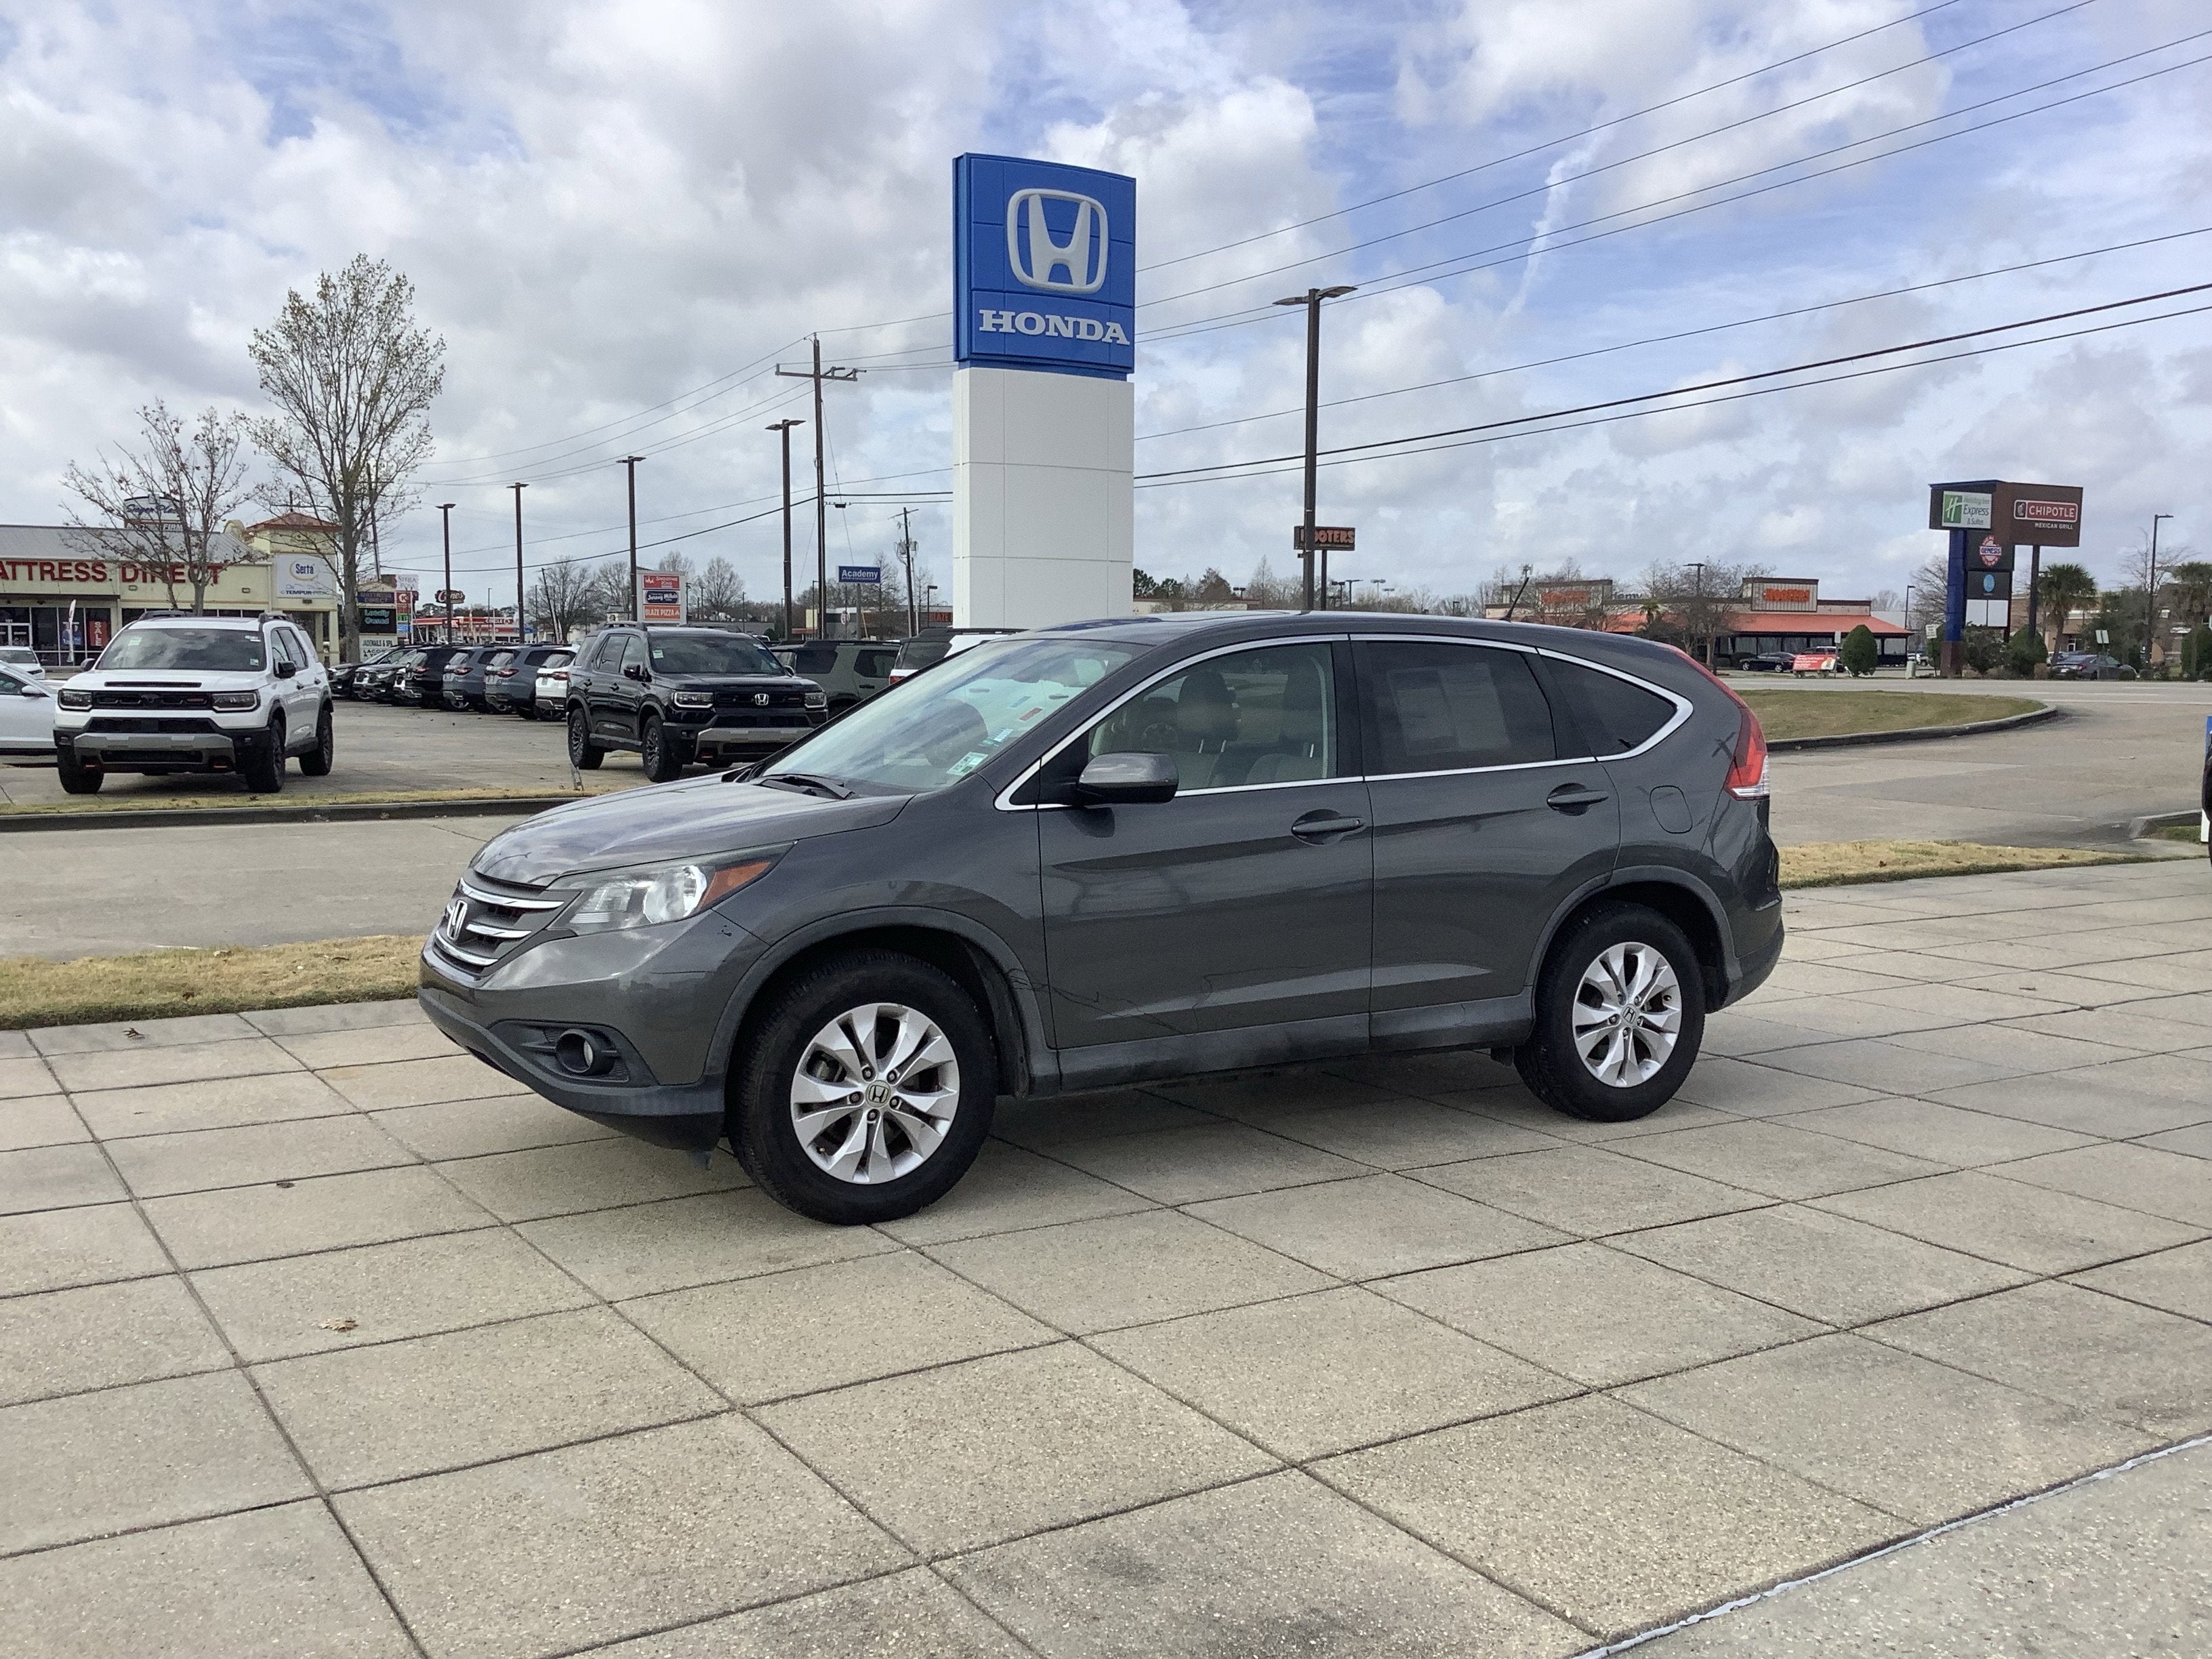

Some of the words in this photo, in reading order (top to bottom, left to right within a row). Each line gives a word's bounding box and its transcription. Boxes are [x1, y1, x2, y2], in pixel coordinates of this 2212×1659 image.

[979, 309, 1130, 346] HONDA
[1963, 504, 1989, 517] Express
[2028, 506, 2075, 518] CHIPOTLE
[295, 563, 314, 574] Serta
[841, 569, 878, 579] Academy
[94, 621, 102, 647] SALE
